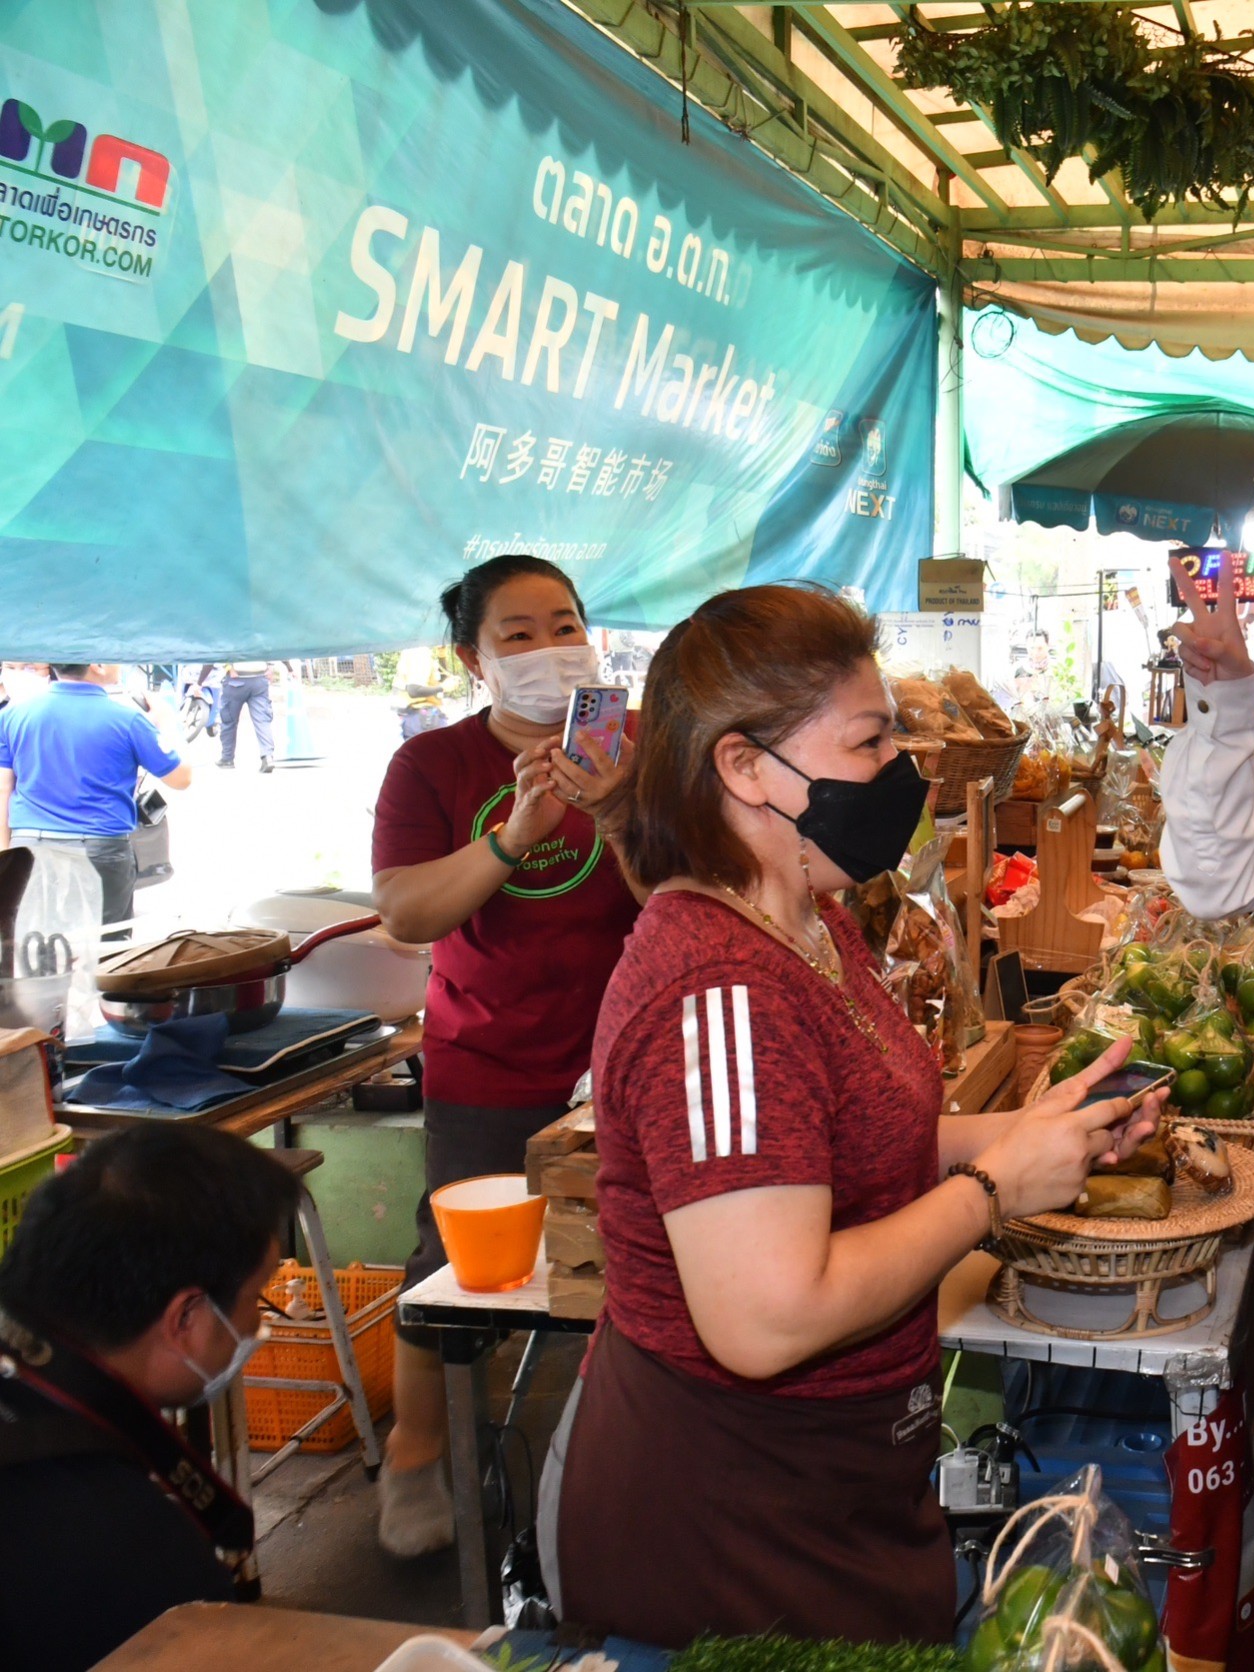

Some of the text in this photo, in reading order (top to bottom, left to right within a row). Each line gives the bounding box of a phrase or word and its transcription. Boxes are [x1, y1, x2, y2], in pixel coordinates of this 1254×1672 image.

[533, 154, 732, 306] ตลาด อ.ต.ก.
[334, 205, 775, 446] SMART Market
[459, 421, 673, 503] 阿多哥智能市场
[844, 488, 897, 521] NEXT
[1143, 512, 1192, 533] NEXT
[530, 835, 566, 853] oney
[1187, 1460, 1236, 1494] 063
